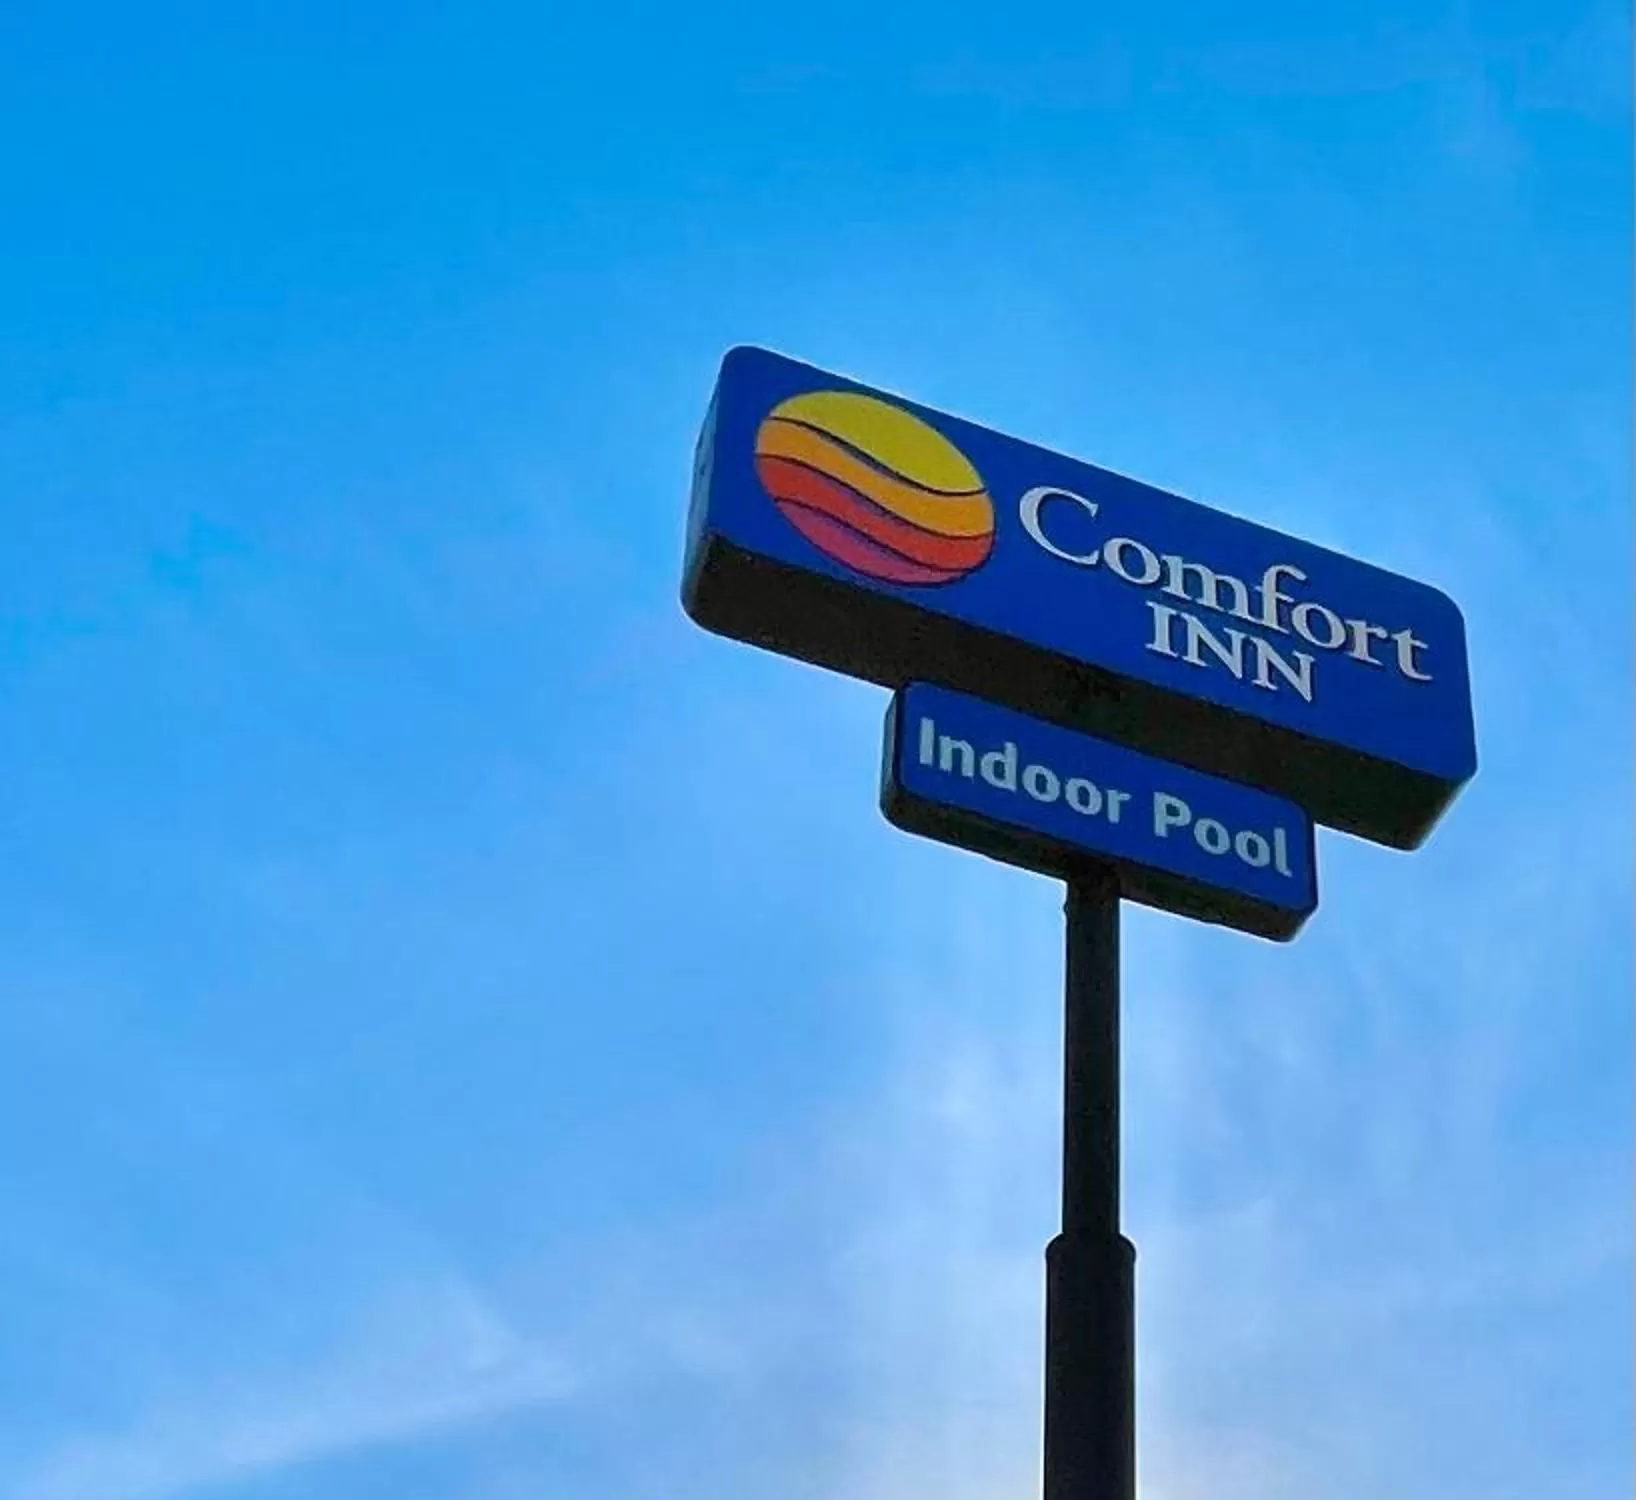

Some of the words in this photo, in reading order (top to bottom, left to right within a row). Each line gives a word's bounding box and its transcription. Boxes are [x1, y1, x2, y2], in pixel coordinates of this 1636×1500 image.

[1018, 485, 1434, 681] Comfort
[1145, 601, 1316, 702] INN
[918, 717, 1132, 825] Indoor
[1153, 791, 1293, 877] Pool
